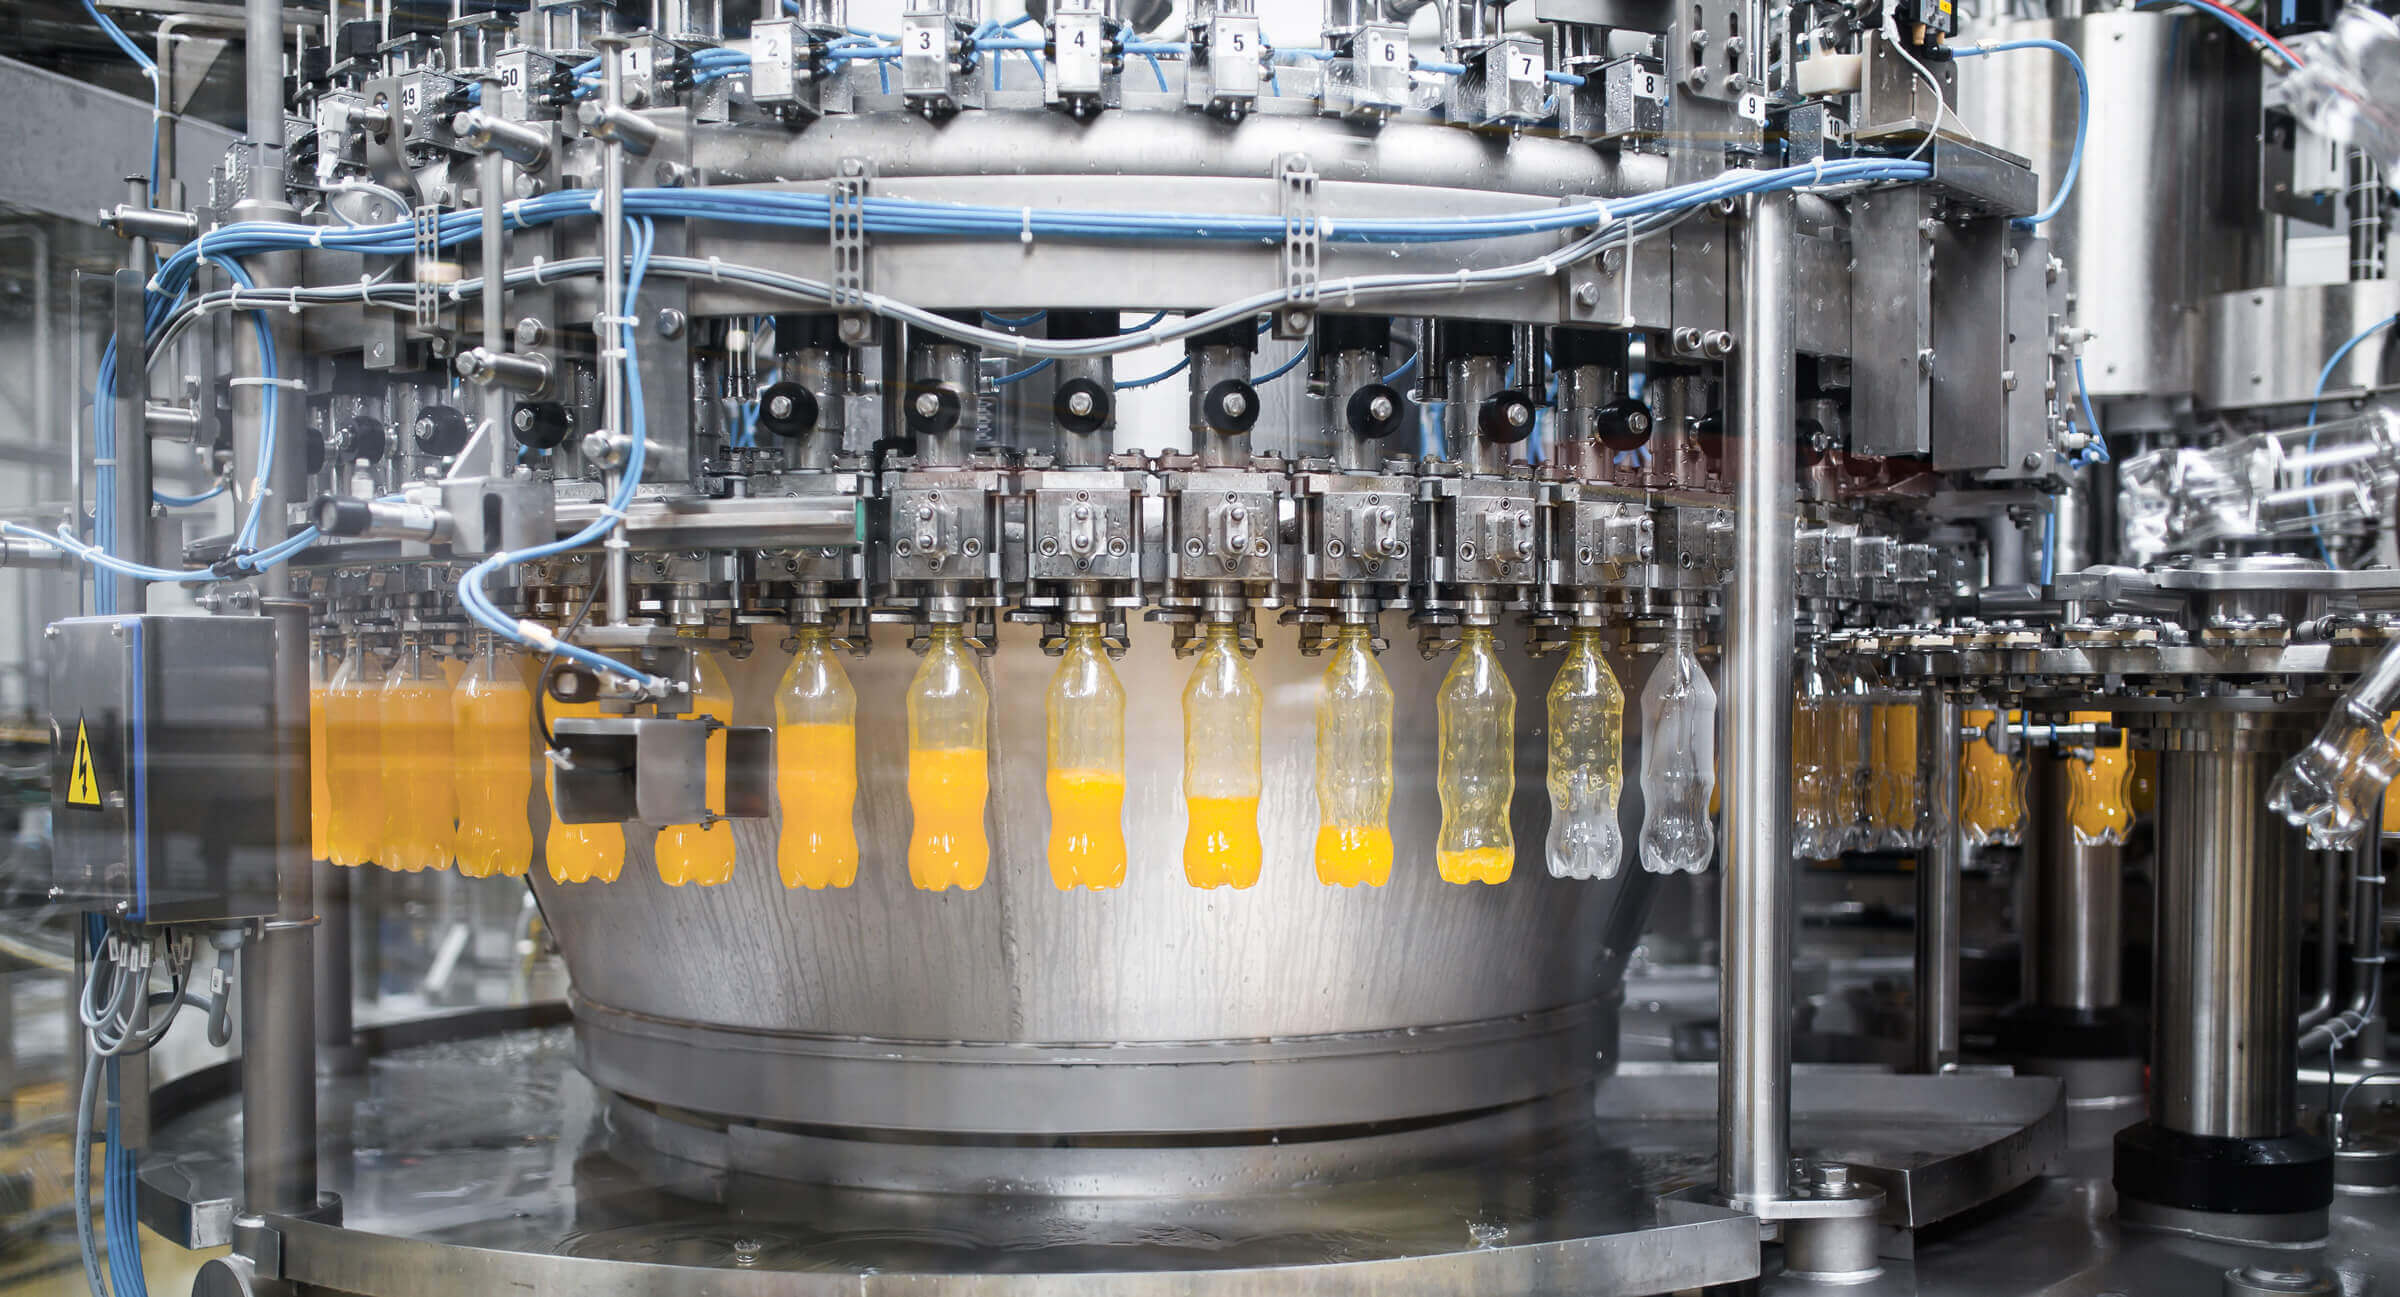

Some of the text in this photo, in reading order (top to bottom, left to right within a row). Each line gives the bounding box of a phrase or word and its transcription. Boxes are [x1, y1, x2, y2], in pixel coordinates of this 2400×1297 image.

[920, 32, 930, 49] 3
[1074, 31, 1085, 47] 4
[1234, 34, 1243, 51] 5
[767, 39, 778, 57] 2
[1385, 44, 1394, 61] 6
[630, 52, 636, 69] 1
[1522, 58, 1531, 75] 7
[502, 68, 517, 87] 50
[1646, 76, 1655, 93] 8
[1749, 98, 1755, 114] 9
[1829, 120, 1840, 137] 10
